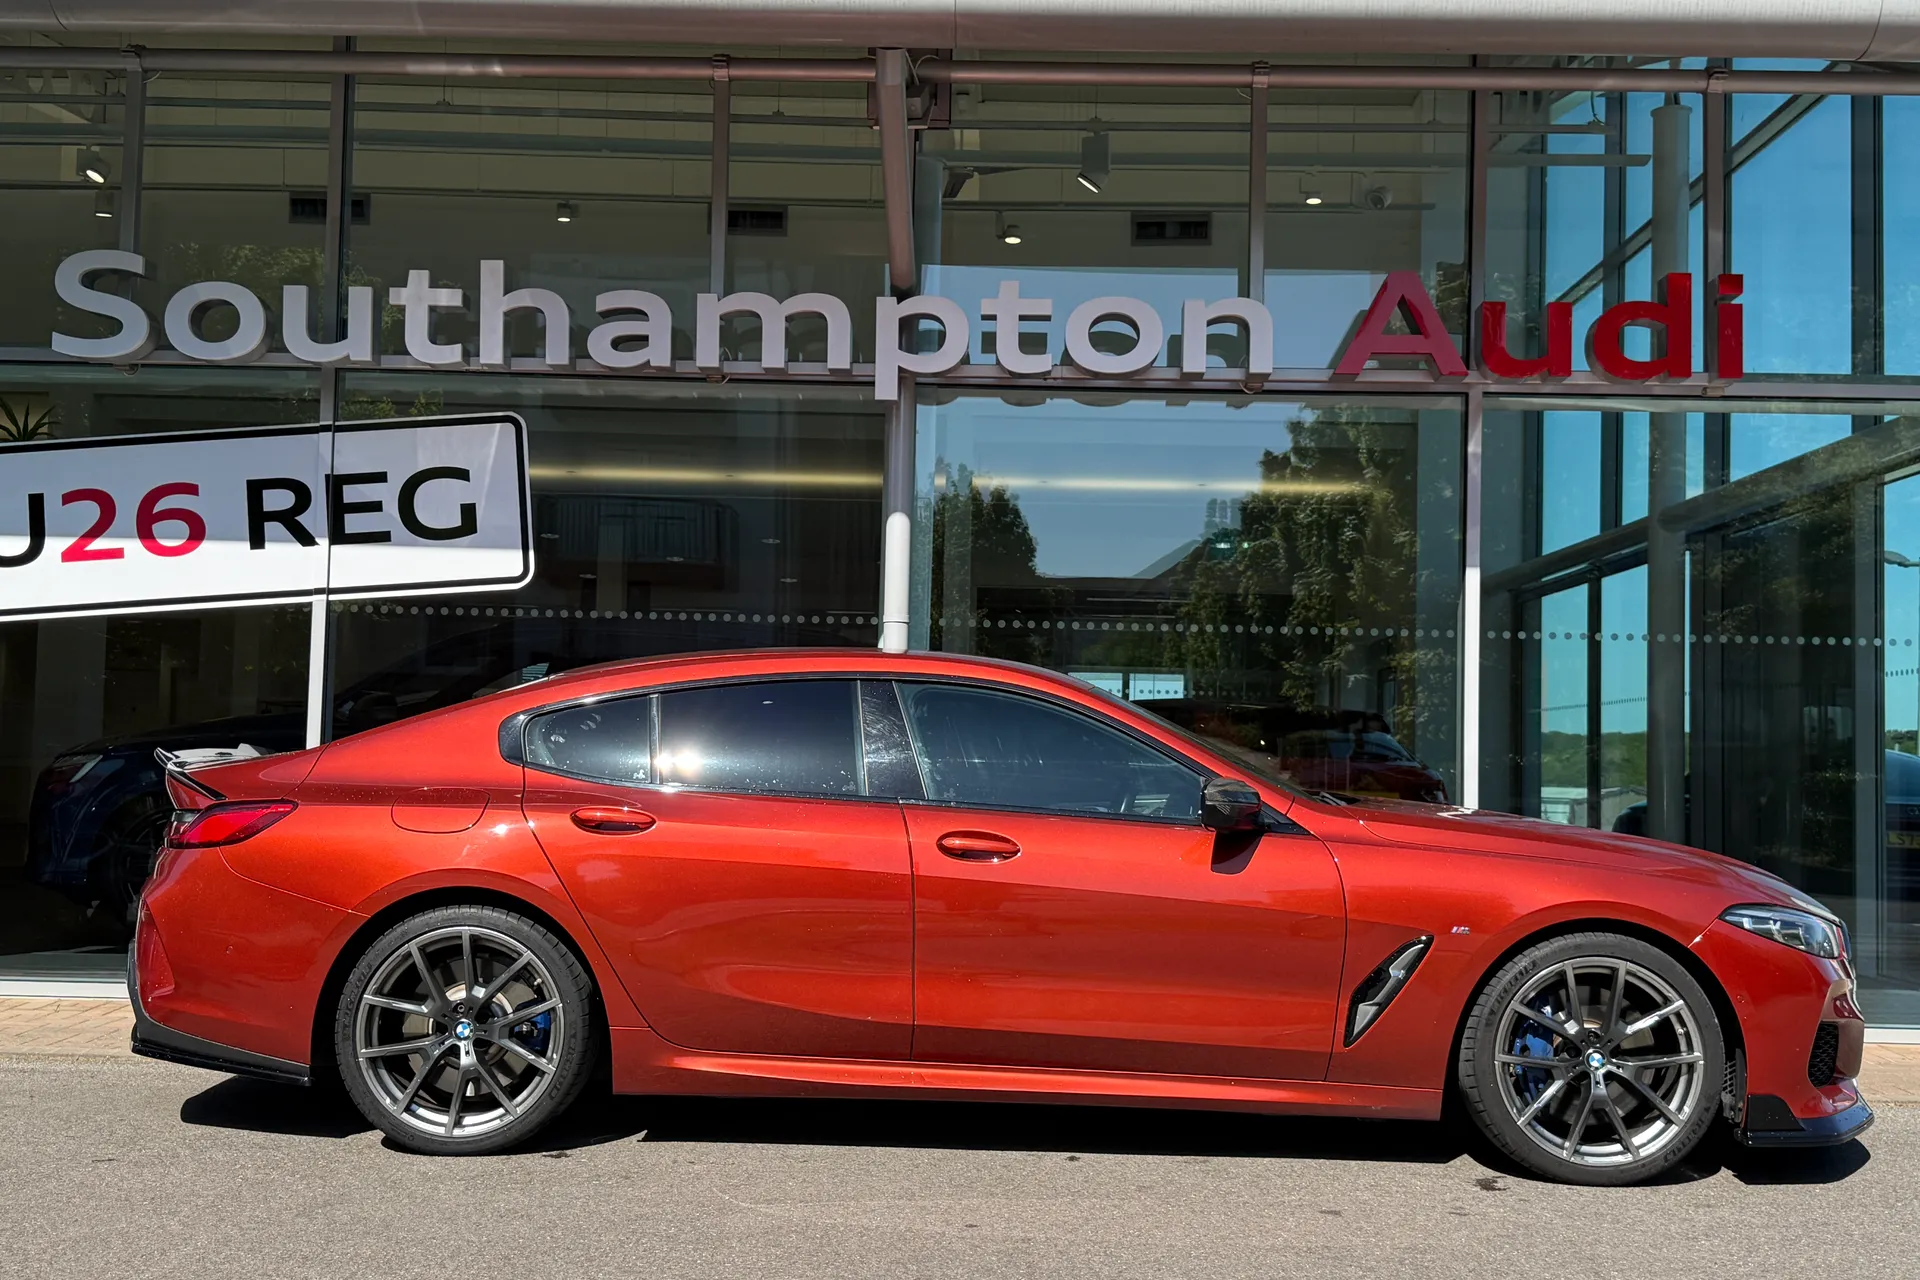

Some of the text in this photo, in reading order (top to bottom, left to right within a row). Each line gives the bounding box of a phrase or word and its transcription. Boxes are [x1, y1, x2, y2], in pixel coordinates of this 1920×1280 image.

[51, 249, 1744, 401] Southampton Audi
[246, 466, 478, 551] REG
